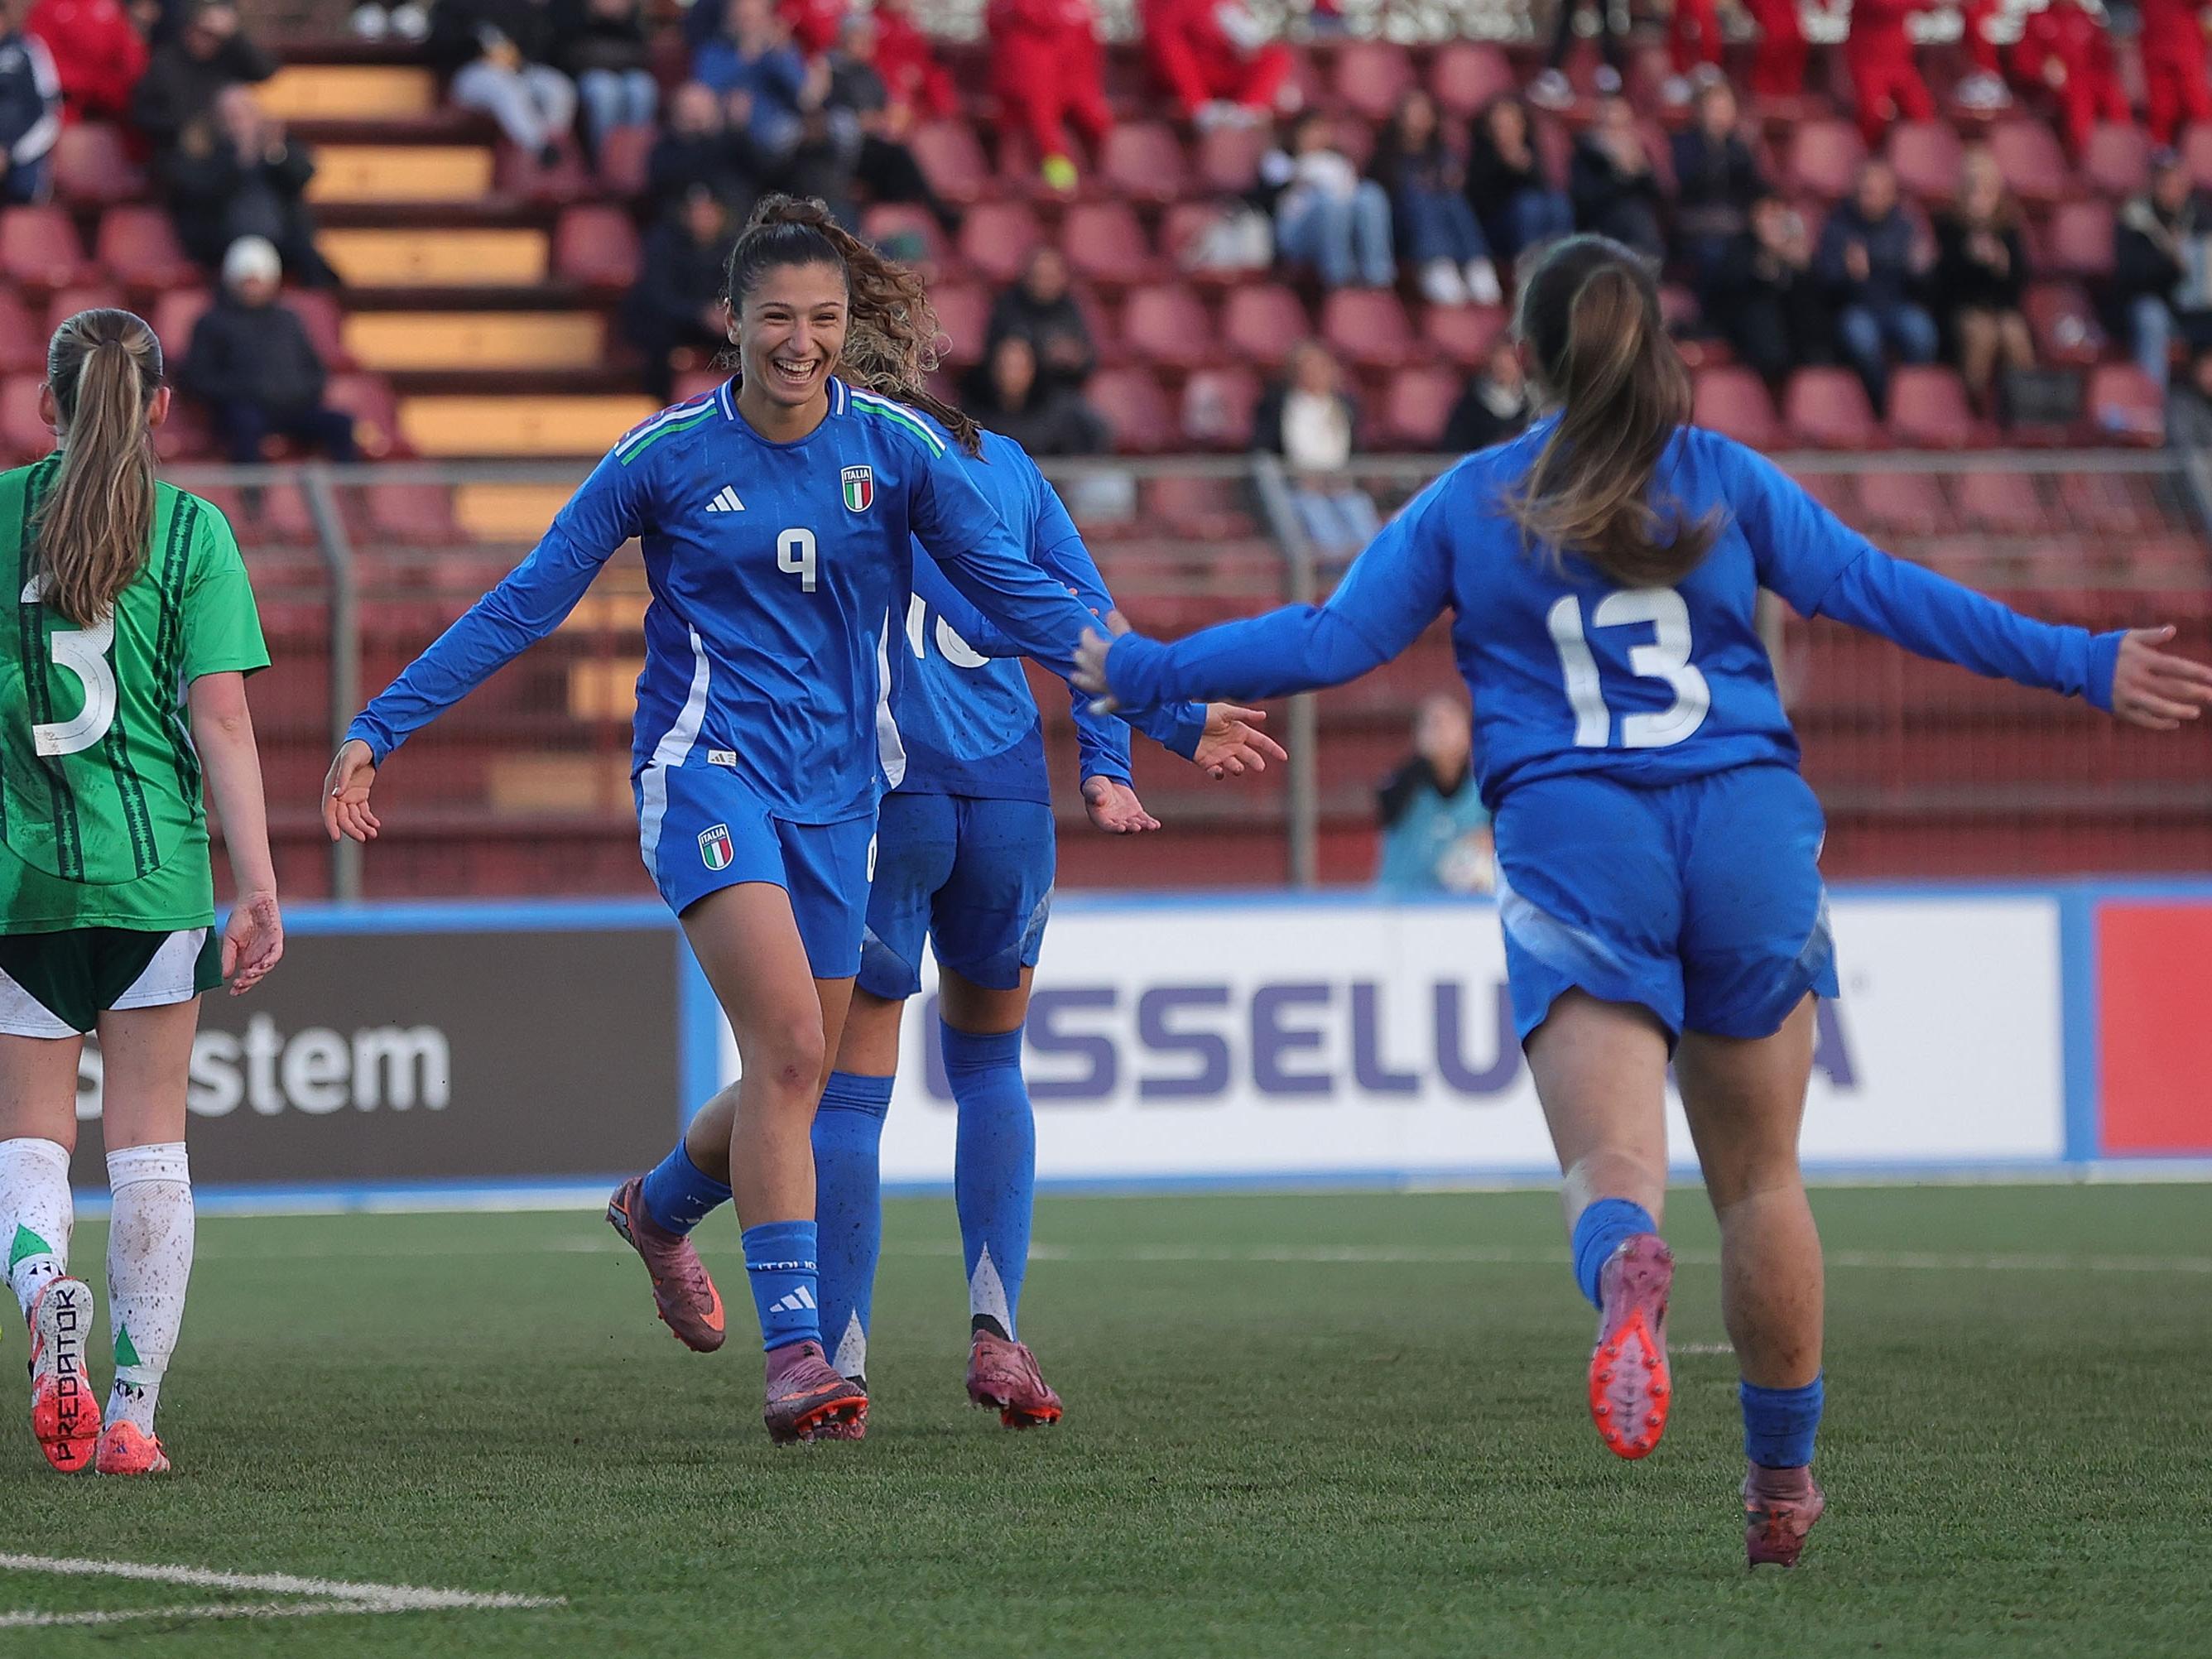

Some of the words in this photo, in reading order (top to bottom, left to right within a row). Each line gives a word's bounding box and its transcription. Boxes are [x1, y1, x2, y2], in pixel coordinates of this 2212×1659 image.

[844, 469, 869, 480] ITALIA
[777, 527, 816, 593] 9
[20, 571, 118, 757] 3
[1546, 586, 1711, 748] 13
[700, 827, 727, 845] ITALIA
[924, 982, 1854, 1099] SSELUA
[55, 1288, 79, 1462] PREDATOR
